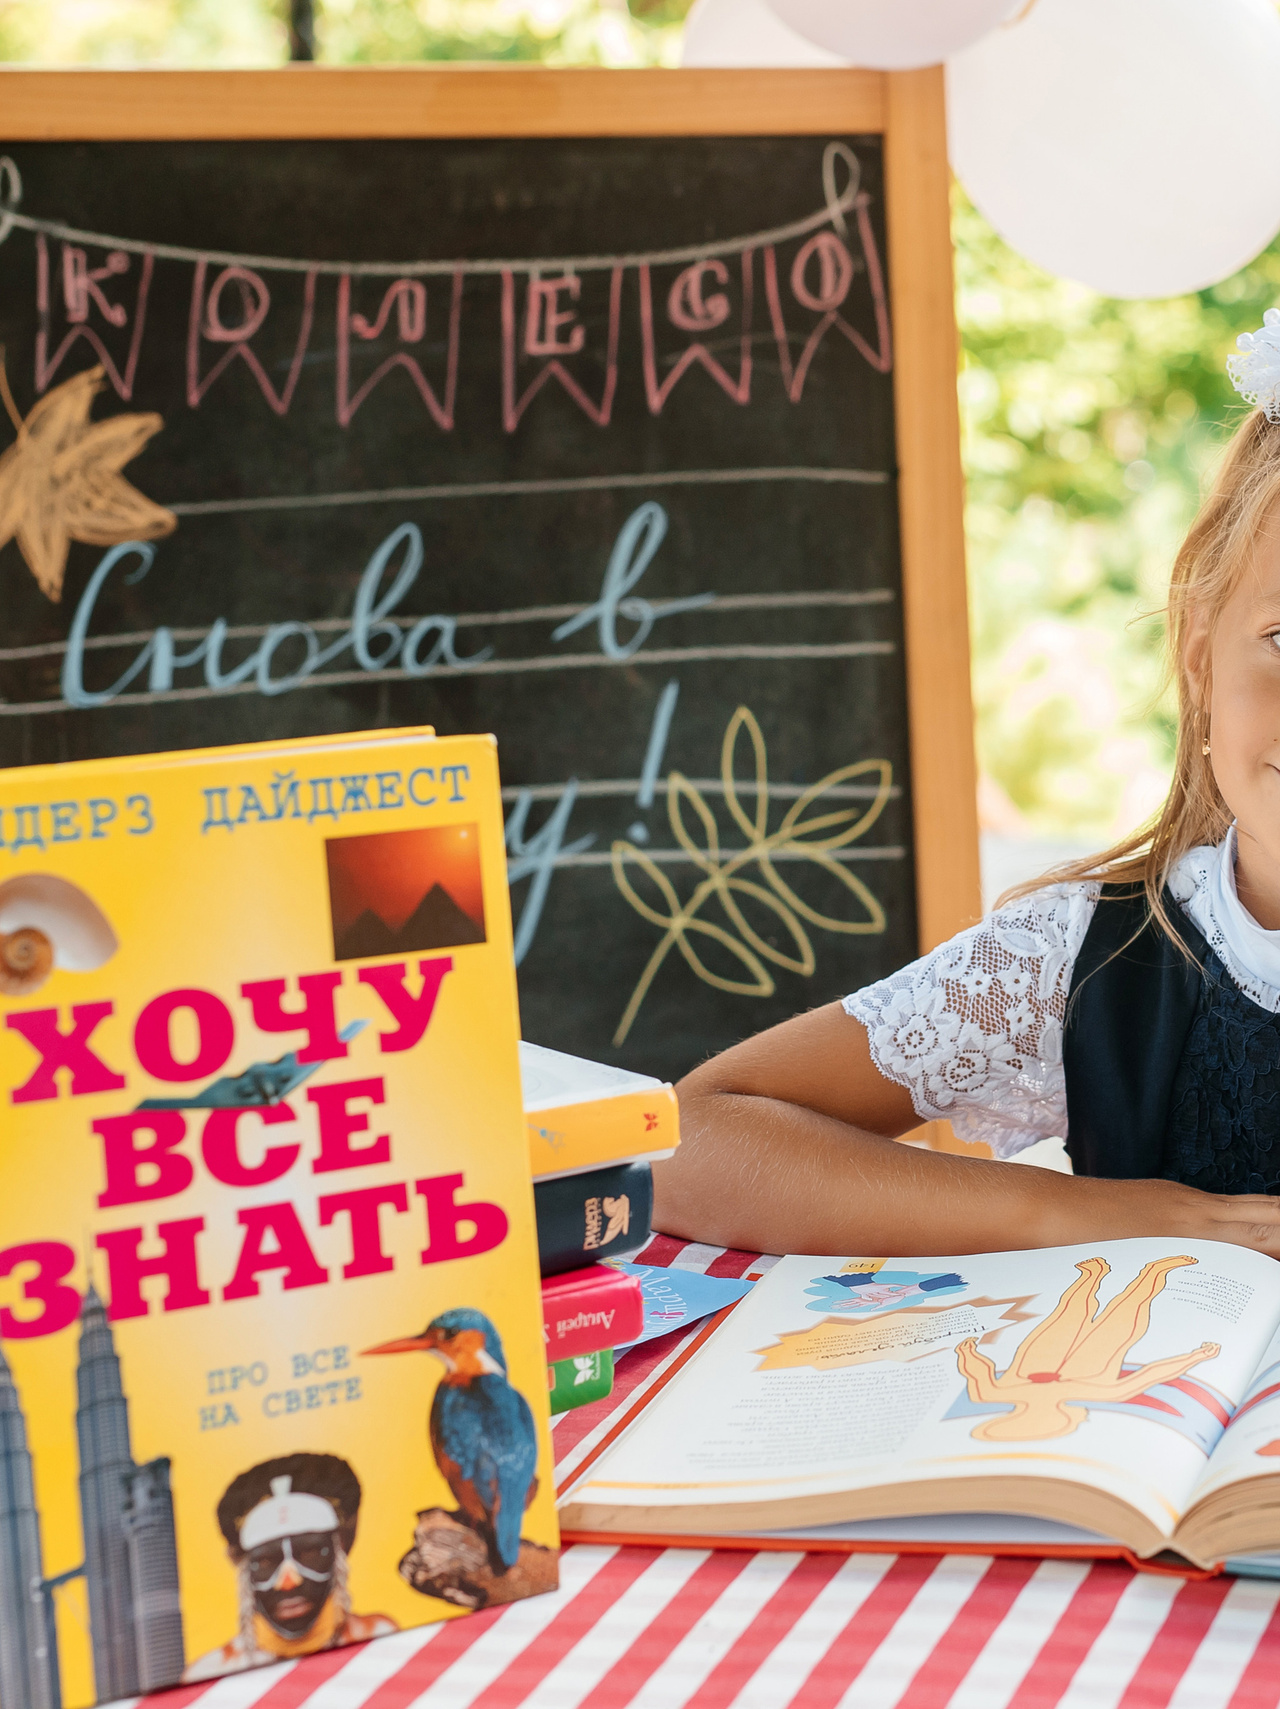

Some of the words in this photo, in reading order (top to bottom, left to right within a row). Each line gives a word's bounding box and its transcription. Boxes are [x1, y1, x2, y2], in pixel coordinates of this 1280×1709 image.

[60, 521, 495, 707] Снова
[0, 793, 155, 855] ДЕРЗ
[200, 764, 471, 834] ДАЙДЖЕСТ
[5, 955, 454, 1105] ХОЧУ
[91, 1076, 392, 1208] ВСЕ
[0, 1173, 510, 1342] ЗНАТЬ
[846, 1262, 876, 1271] 149
[556, 1309, 616, 1339] Андрей
[199, 1404, 241, 1431] НА
[262, 1376, 363, 1419] СВЕТЕ
[206, 1362, 270, 1397] ПРО
[291, 1346, 350, 1379] ВСЕ
